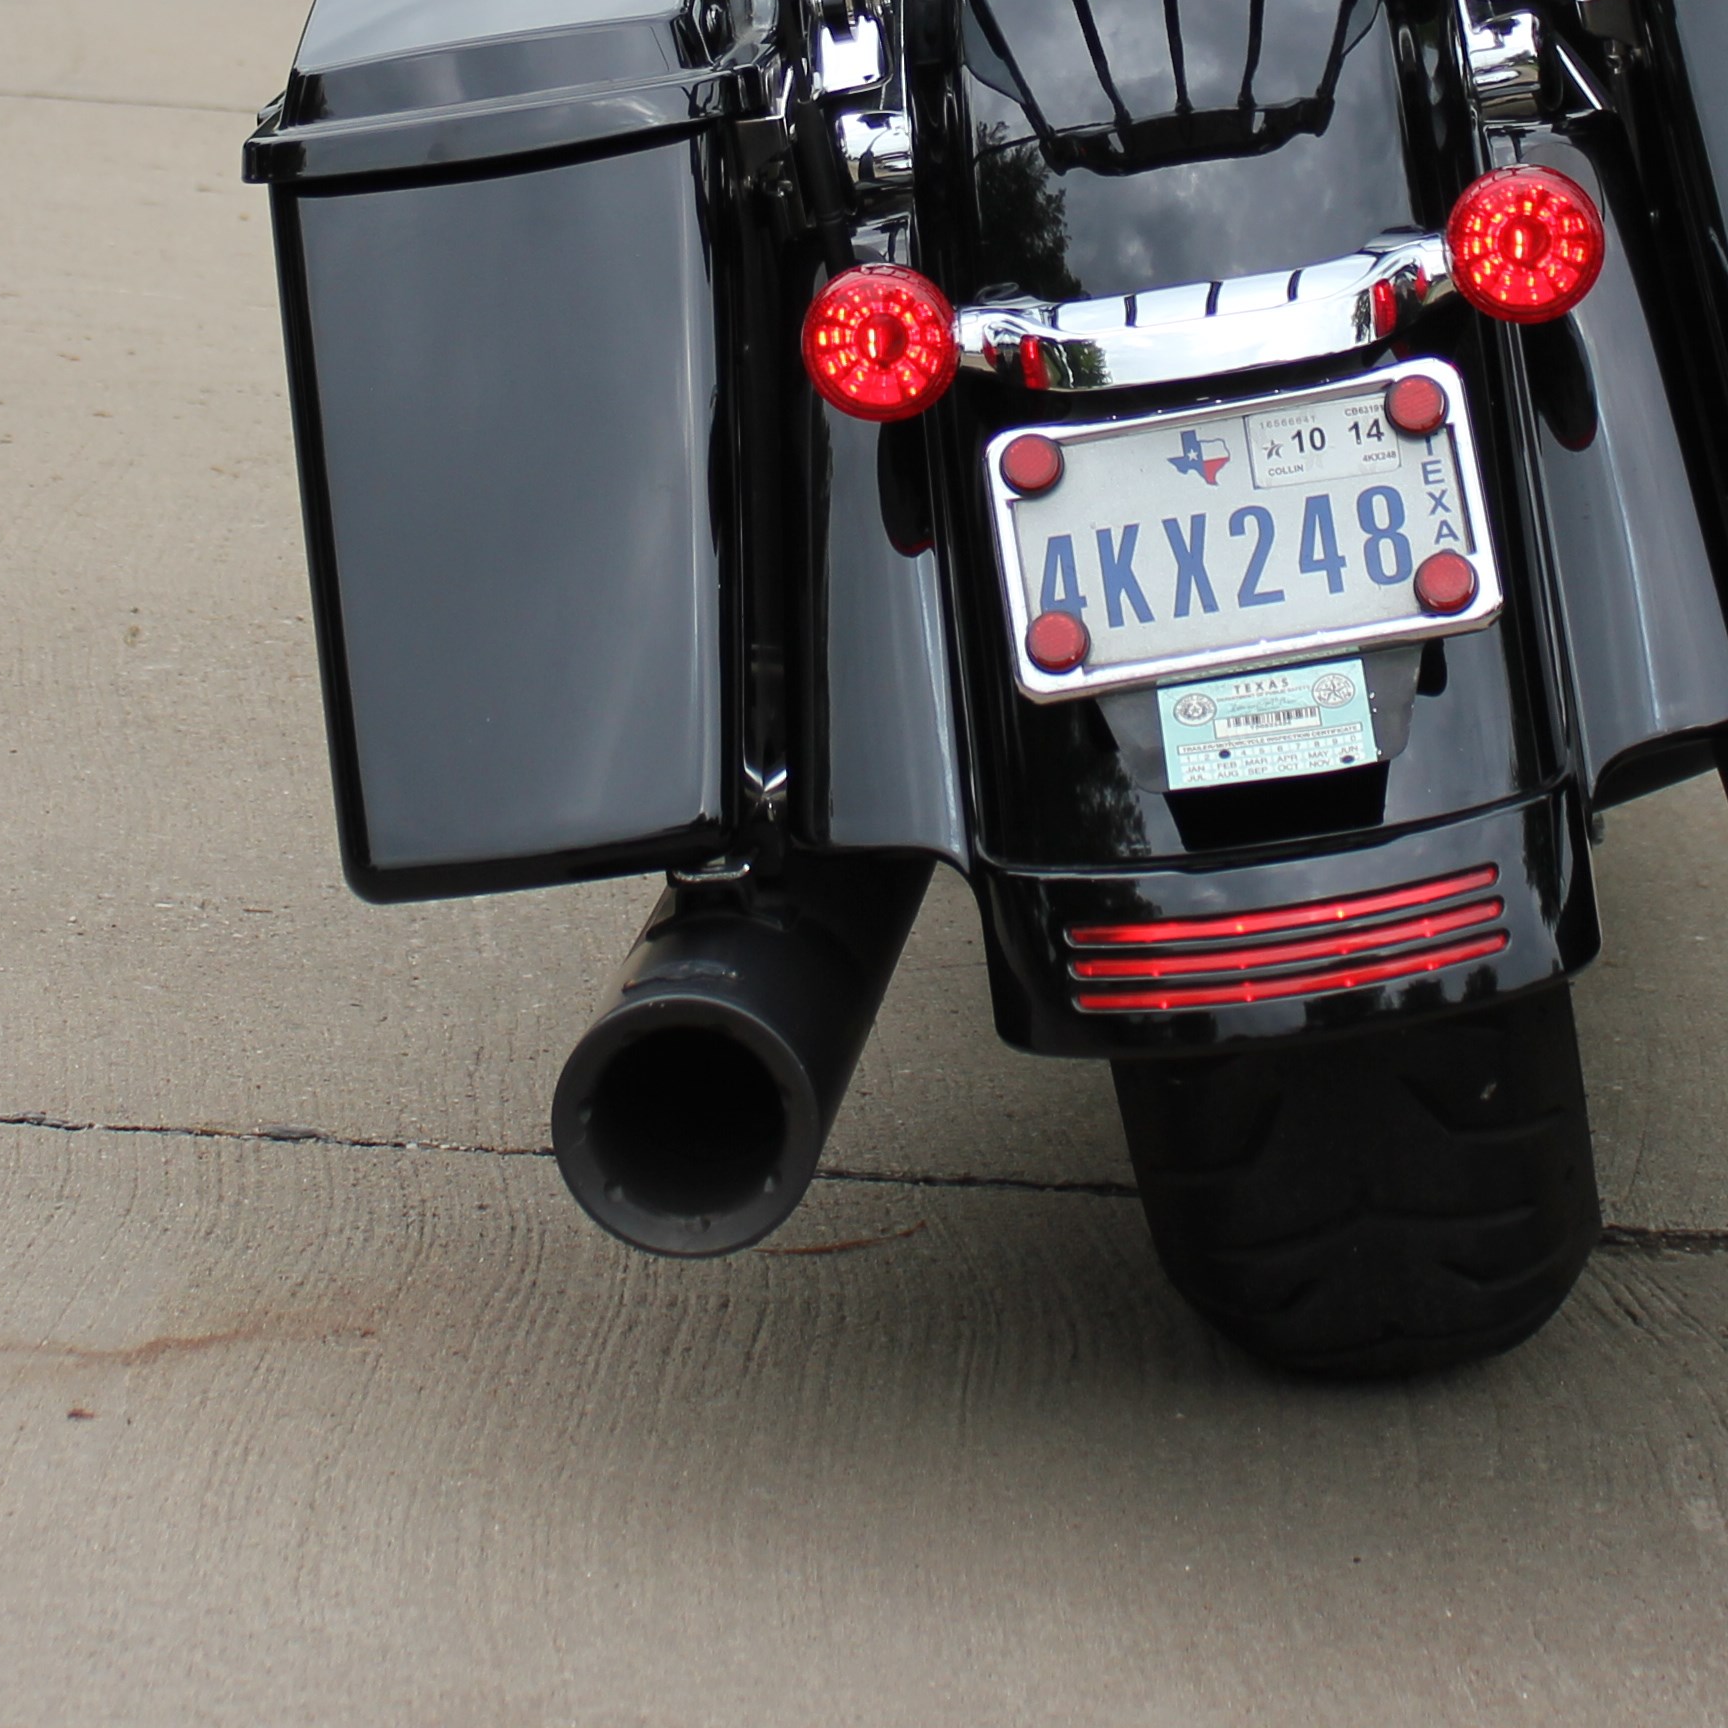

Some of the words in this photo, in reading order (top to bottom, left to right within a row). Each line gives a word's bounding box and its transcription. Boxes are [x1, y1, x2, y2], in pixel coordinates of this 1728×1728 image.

[1291, 426, 1326, 454] 10
[1348, 418, 1384, 445] 14
[1268, 464, 1304, 477] COLLIN
[1421, 430, 1460, 553] TEXA
[1040, 485, 1413, 629] 4KX248
[1233, 677, 1289, 694] TEXAS
